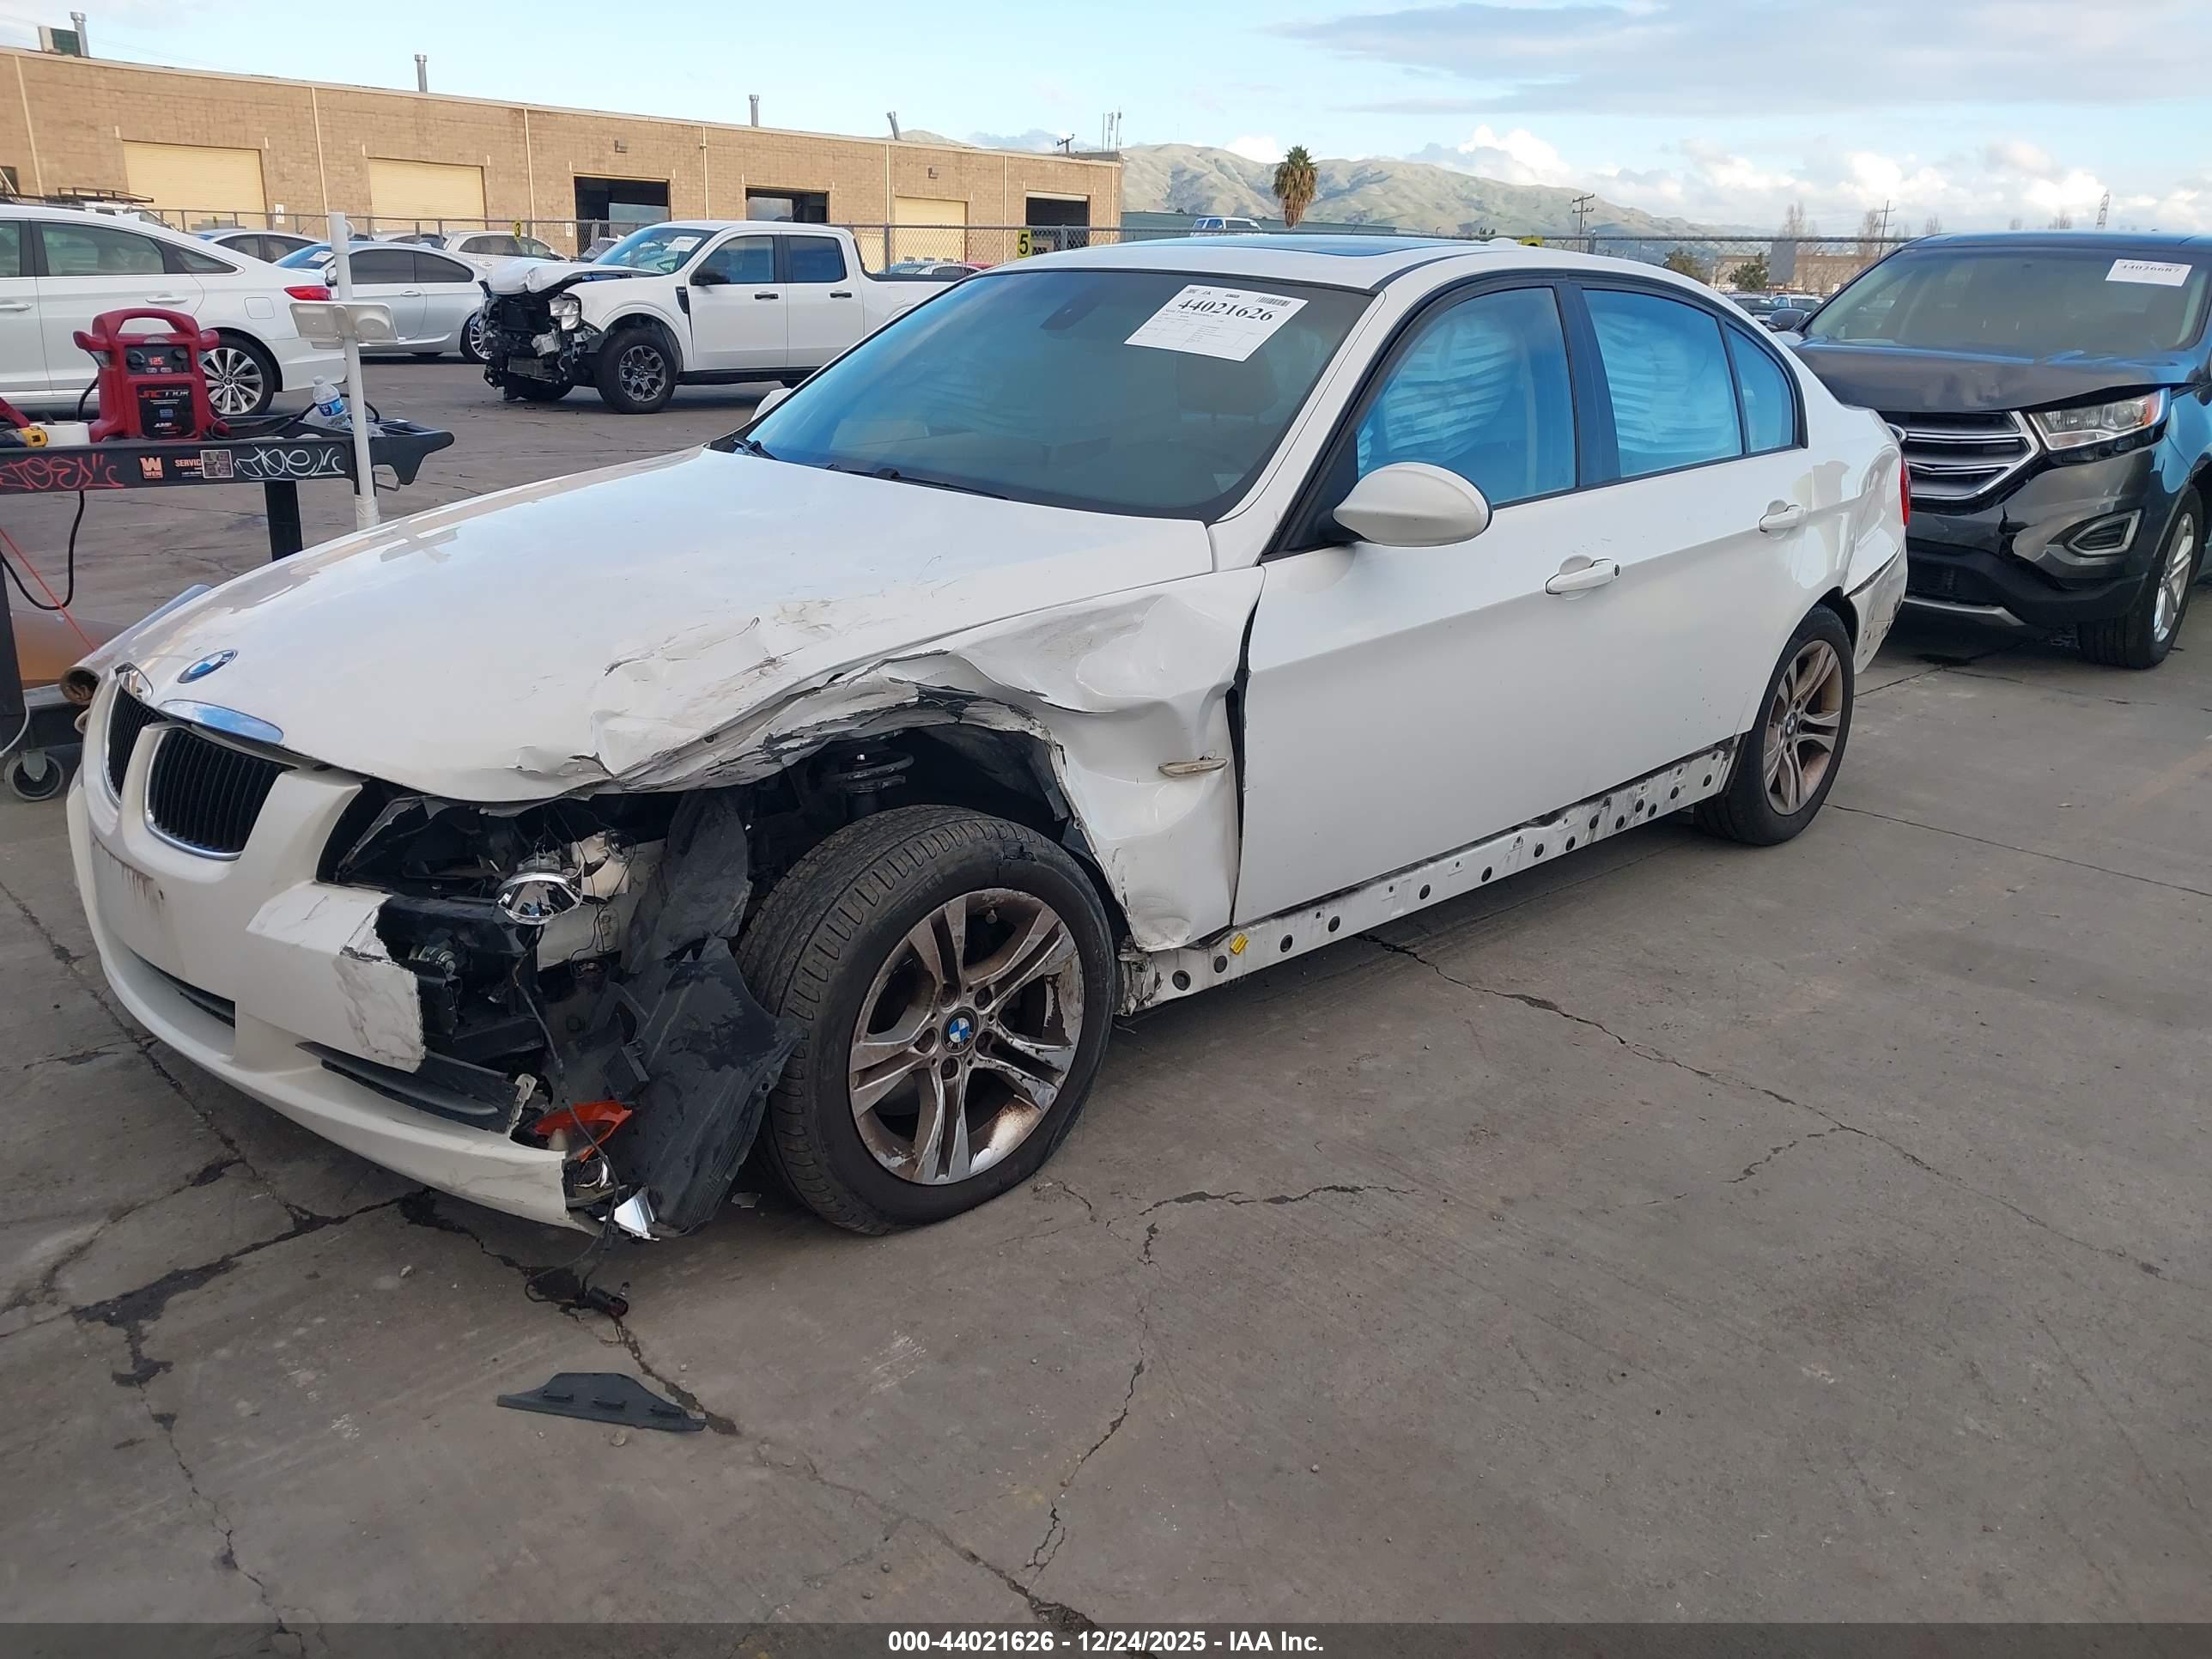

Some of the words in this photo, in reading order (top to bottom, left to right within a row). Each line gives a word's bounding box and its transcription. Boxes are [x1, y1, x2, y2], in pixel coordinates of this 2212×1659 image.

[514, 222, 521, 238] 3
[1019, 233, 1029, 255] 5
[1177, 298, 1279, 322] 44021626
[174, 459, 202, 468] SERVIC
